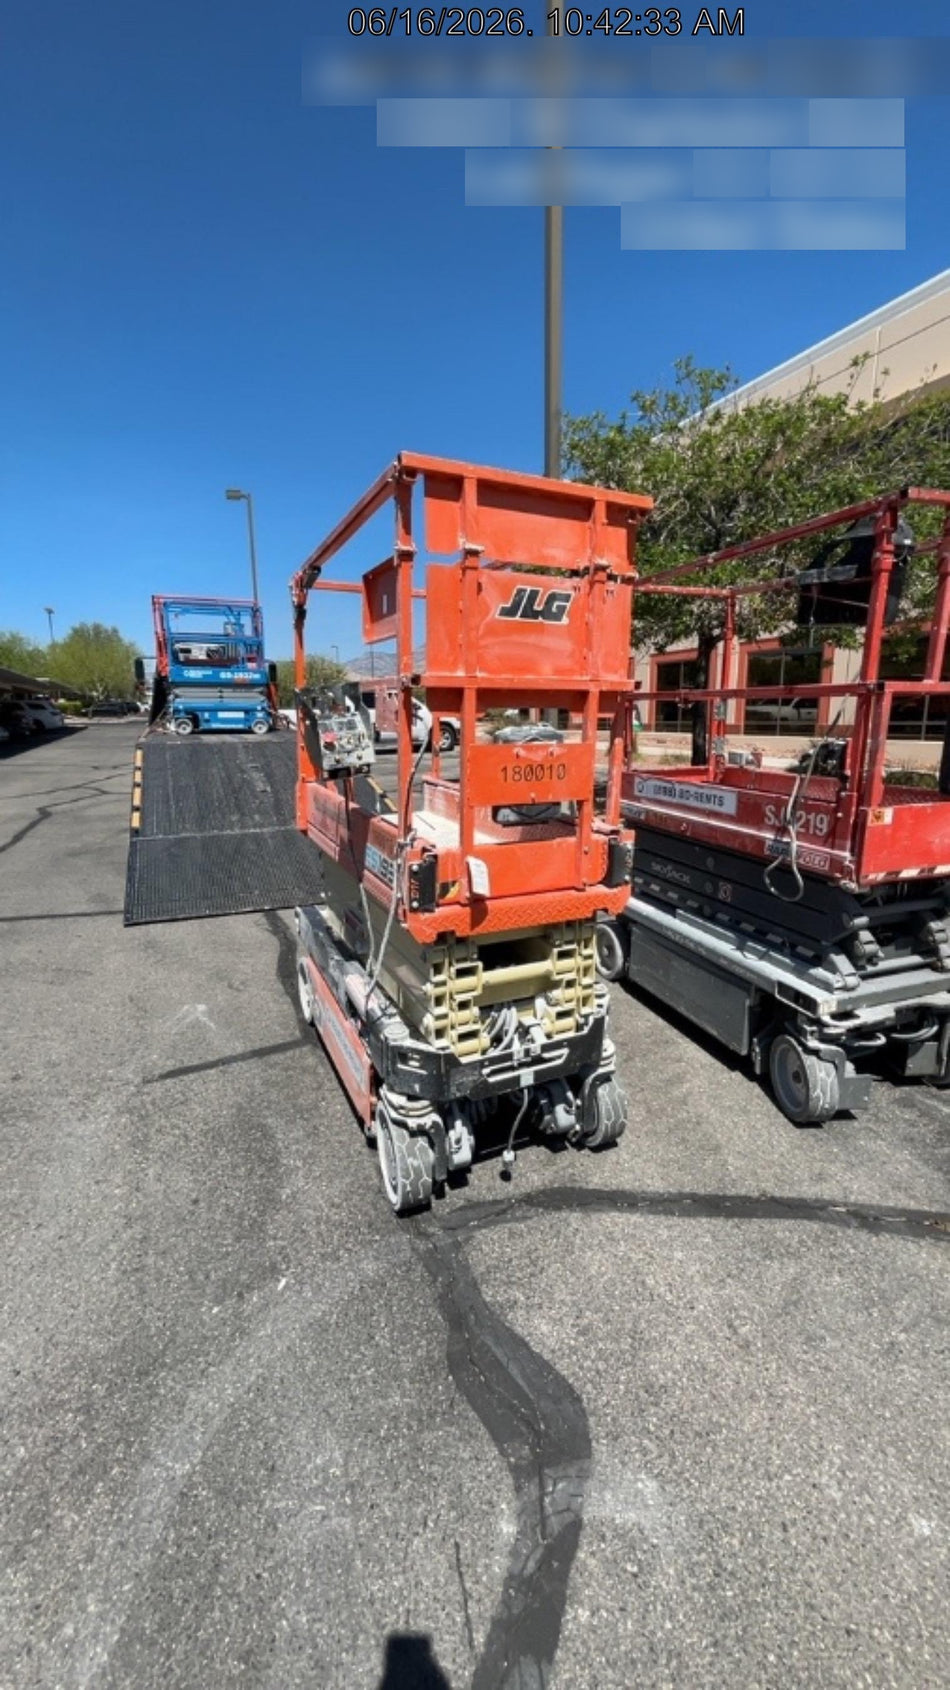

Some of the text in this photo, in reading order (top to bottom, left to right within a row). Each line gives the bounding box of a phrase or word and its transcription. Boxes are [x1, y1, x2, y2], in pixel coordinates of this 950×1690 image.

[496, 585, 575, 624] JLG
[501, 763, 567, 783] 180010
[764, 804, 830, 837] SJ219
